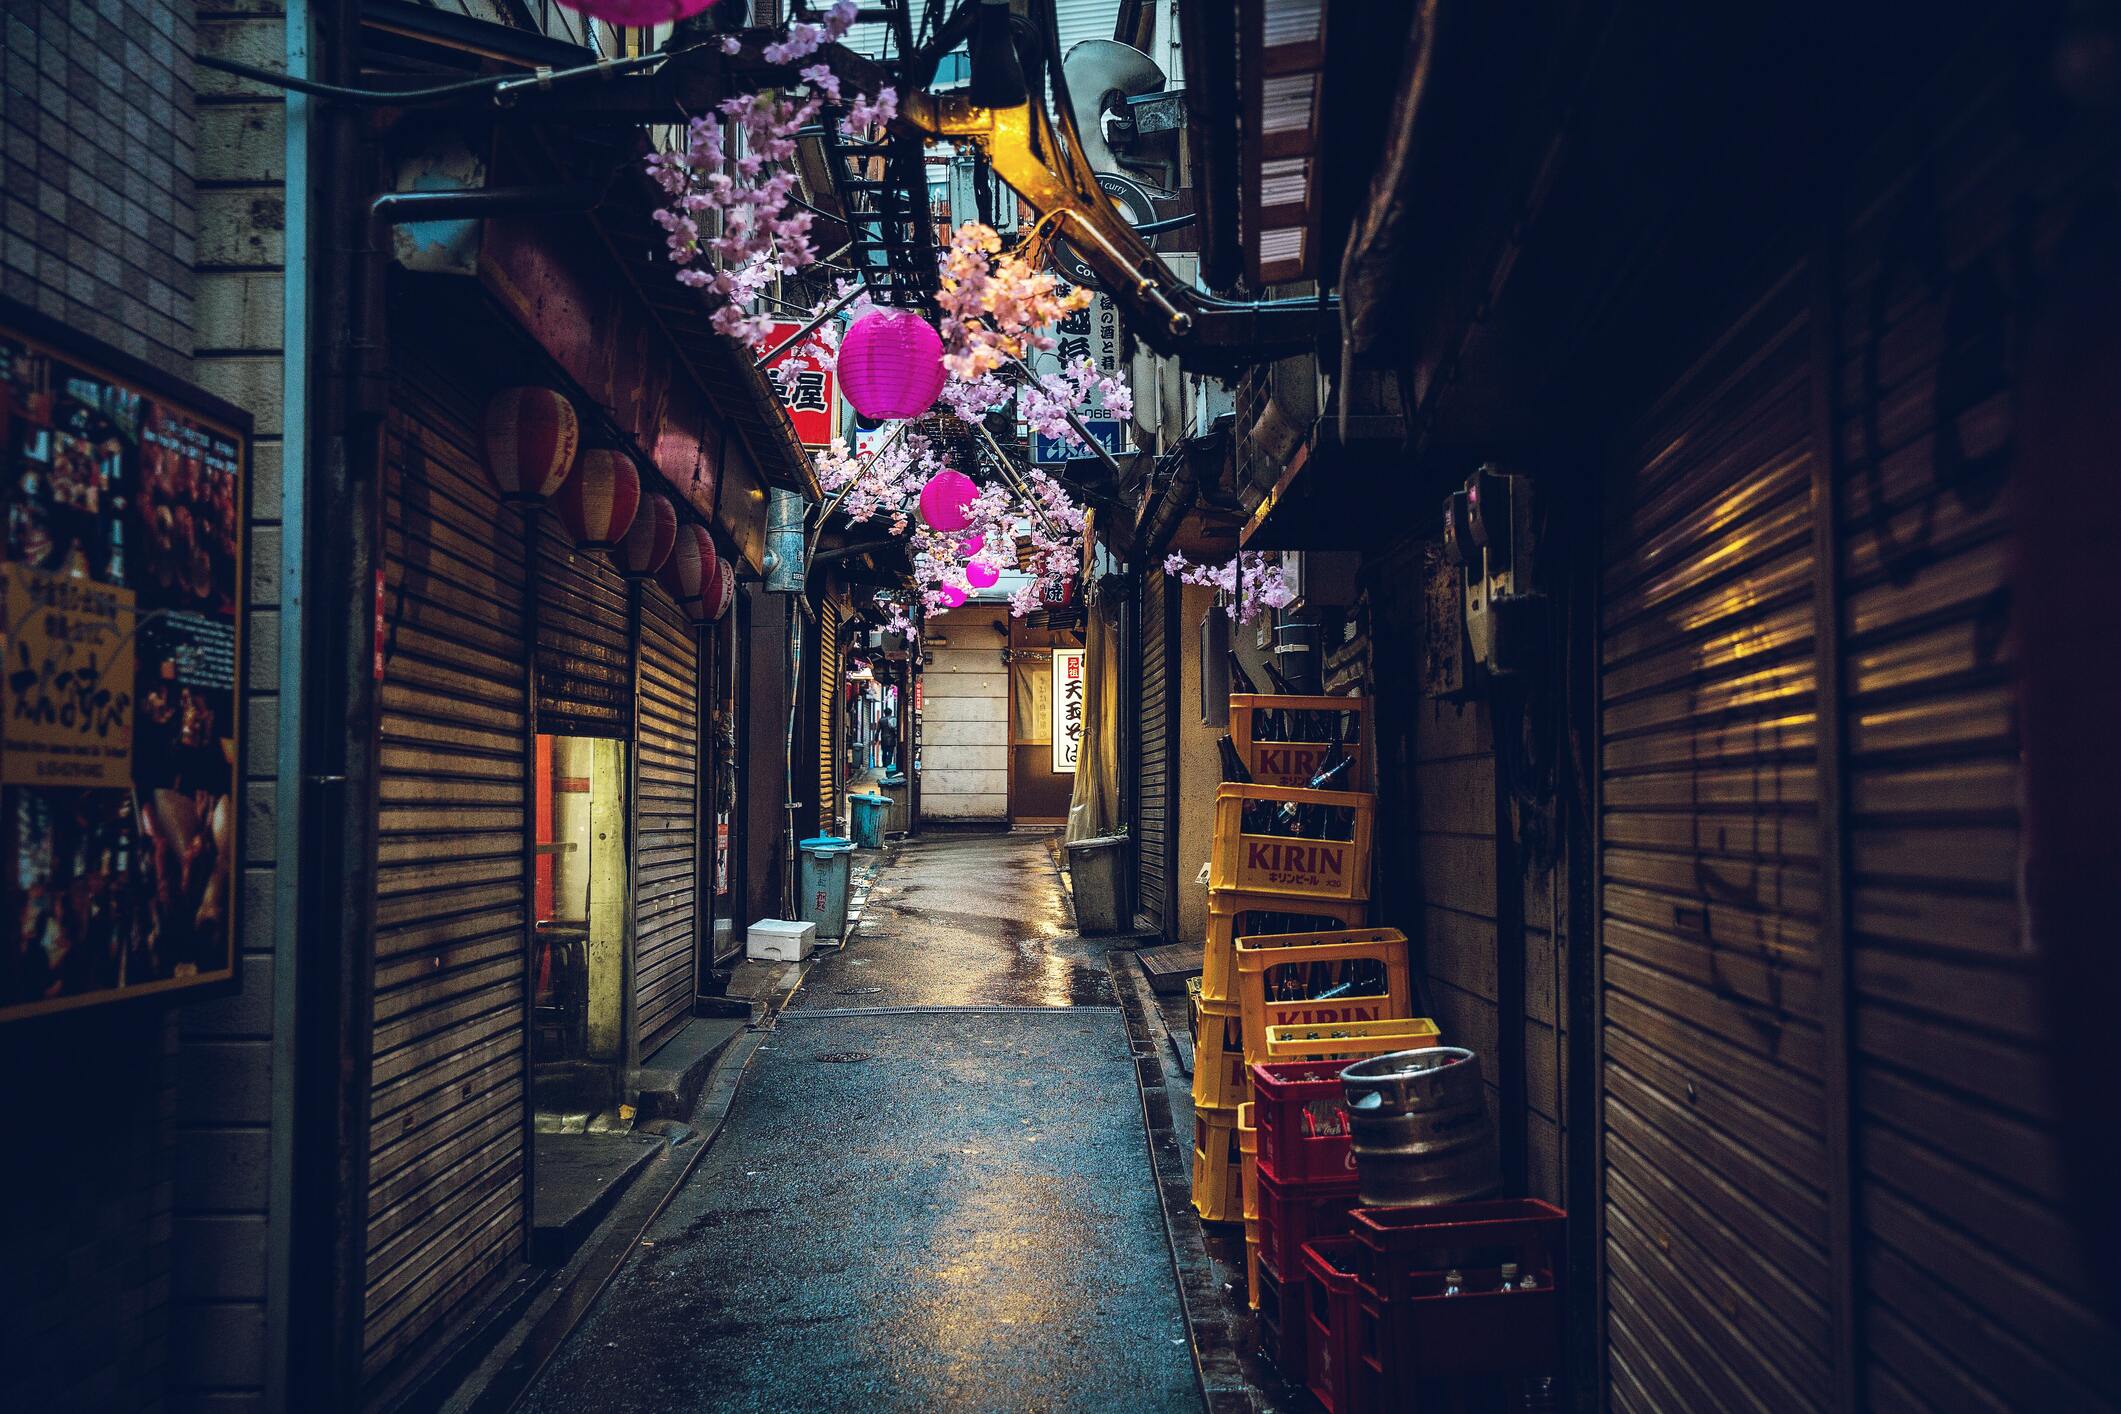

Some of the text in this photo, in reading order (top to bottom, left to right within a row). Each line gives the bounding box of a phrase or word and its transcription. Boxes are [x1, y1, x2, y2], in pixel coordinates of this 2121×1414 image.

[1104, 182, 1127, 196] curry
[1068, 658, 1079, 678] 元祖
[1248, 842, 1343, 876] KIRIN
[1269, 871, 1320, 887] キリンビール
